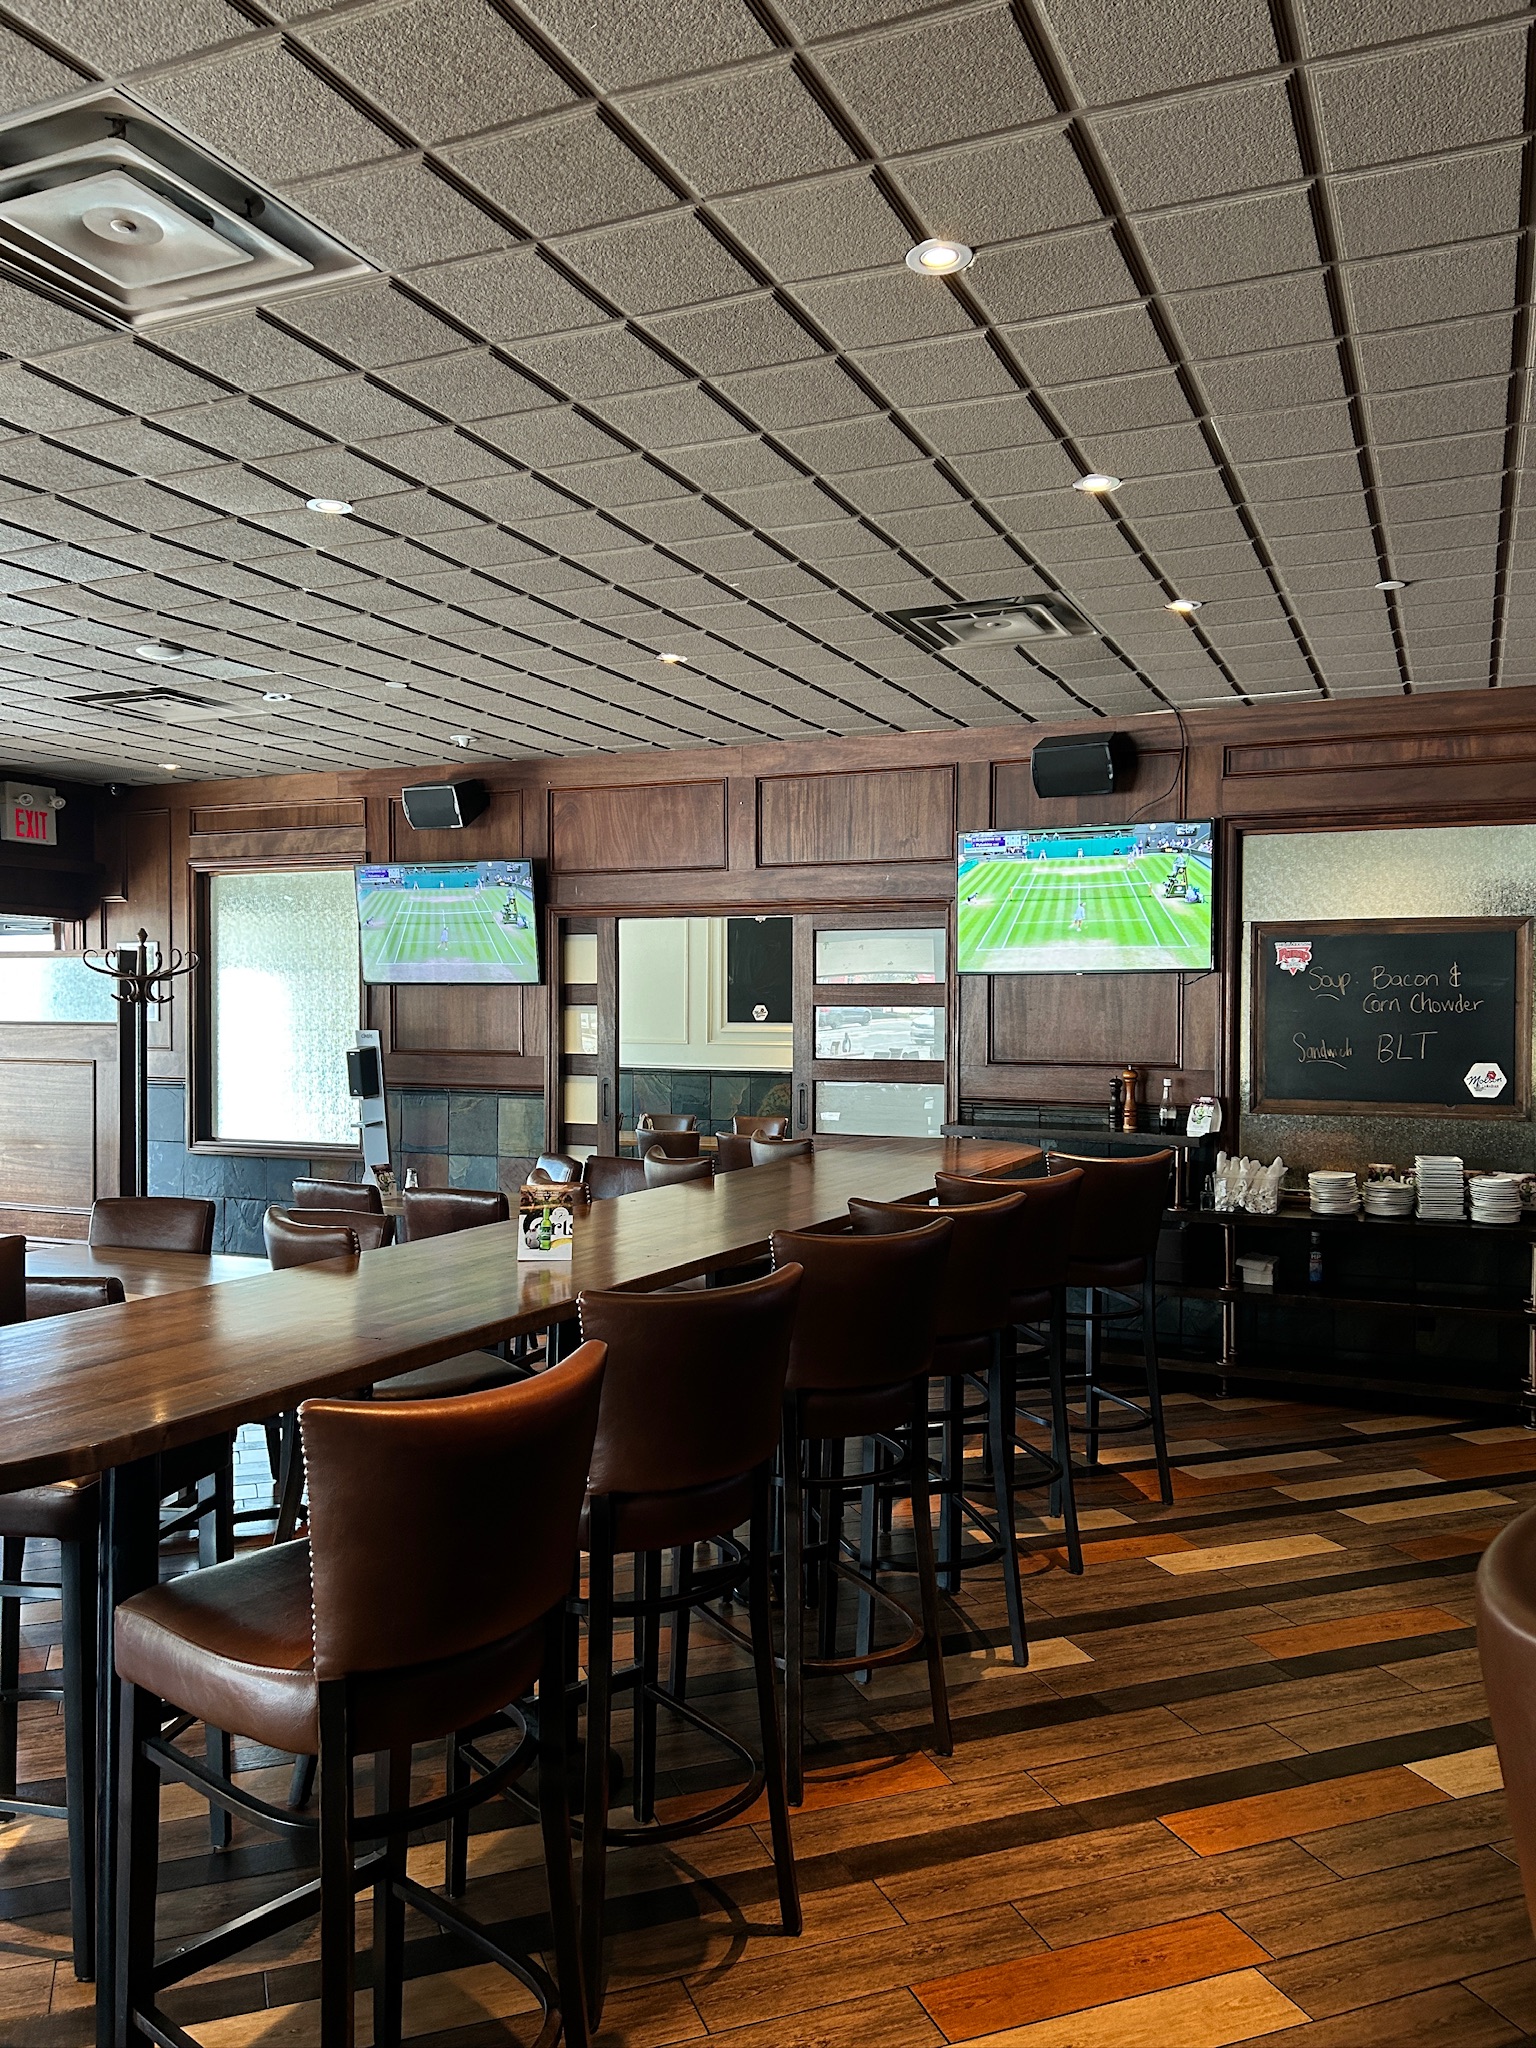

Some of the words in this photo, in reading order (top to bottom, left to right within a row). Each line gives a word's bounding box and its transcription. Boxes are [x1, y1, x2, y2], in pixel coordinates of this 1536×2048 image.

[15, 808, 47, 839] EXIT
[1371, 966, 1439, 989] Bacon
[1449, 962, 1461, 987] &
[1363, 993, 1400, 1013] Corn
[1410, 992, 1484, 1013] Chowder
[1377, 1031, 1438, 1063] BLT
